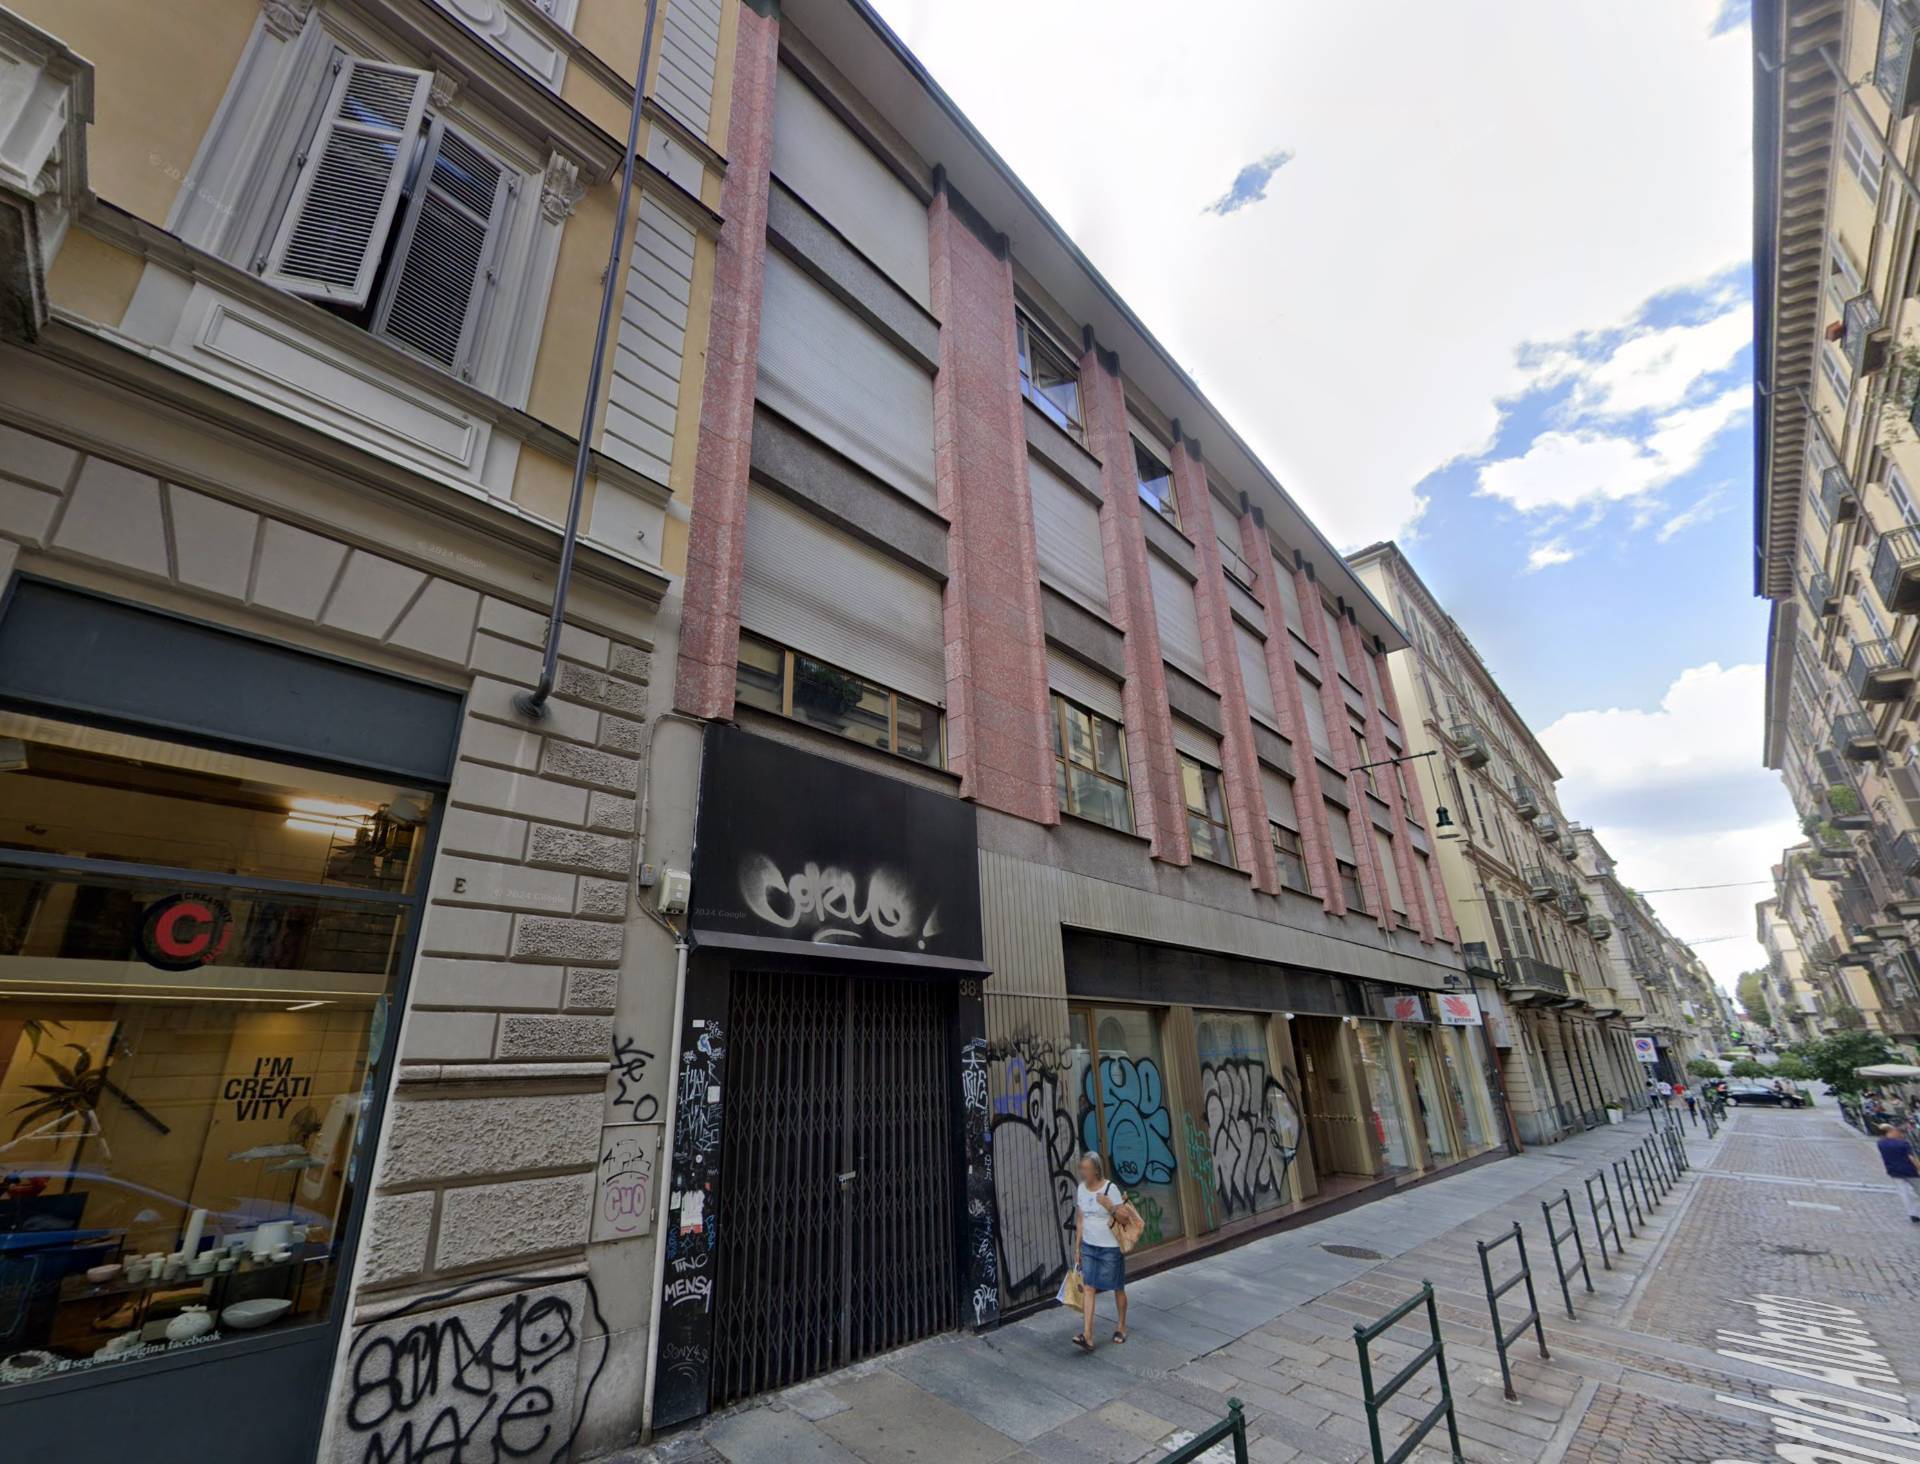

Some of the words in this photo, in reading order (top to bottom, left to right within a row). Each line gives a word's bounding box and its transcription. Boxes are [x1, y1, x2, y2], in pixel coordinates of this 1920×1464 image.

[453, 877, 467, 894] E
[959, 978, 977, 996] 38
[253, 1056, 294, 1078] I'M
[223, 1076, 312, 1101] CREATI
[236, 1097, 293, 1122] VITY
